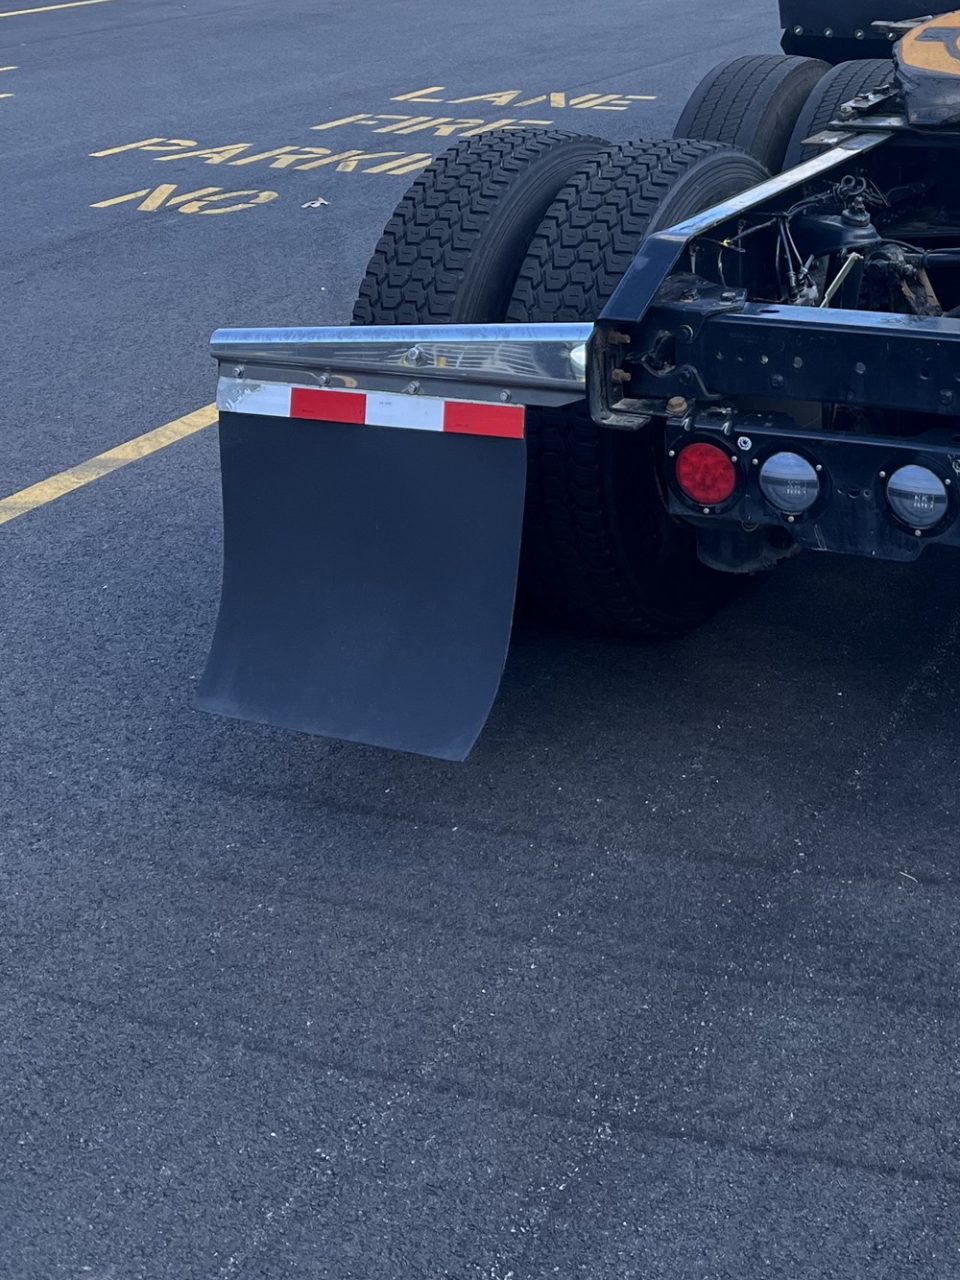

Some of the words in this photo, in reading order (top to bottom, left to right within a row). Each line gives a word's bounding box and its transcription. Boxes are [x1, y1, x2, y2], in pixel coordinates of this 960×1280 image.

[390, 86, 657, 111] LANE
[310, 113, 553, 137] FIRE
[88, 137, 433, 175] PARKI
[89, 183, 278, 215] NO
